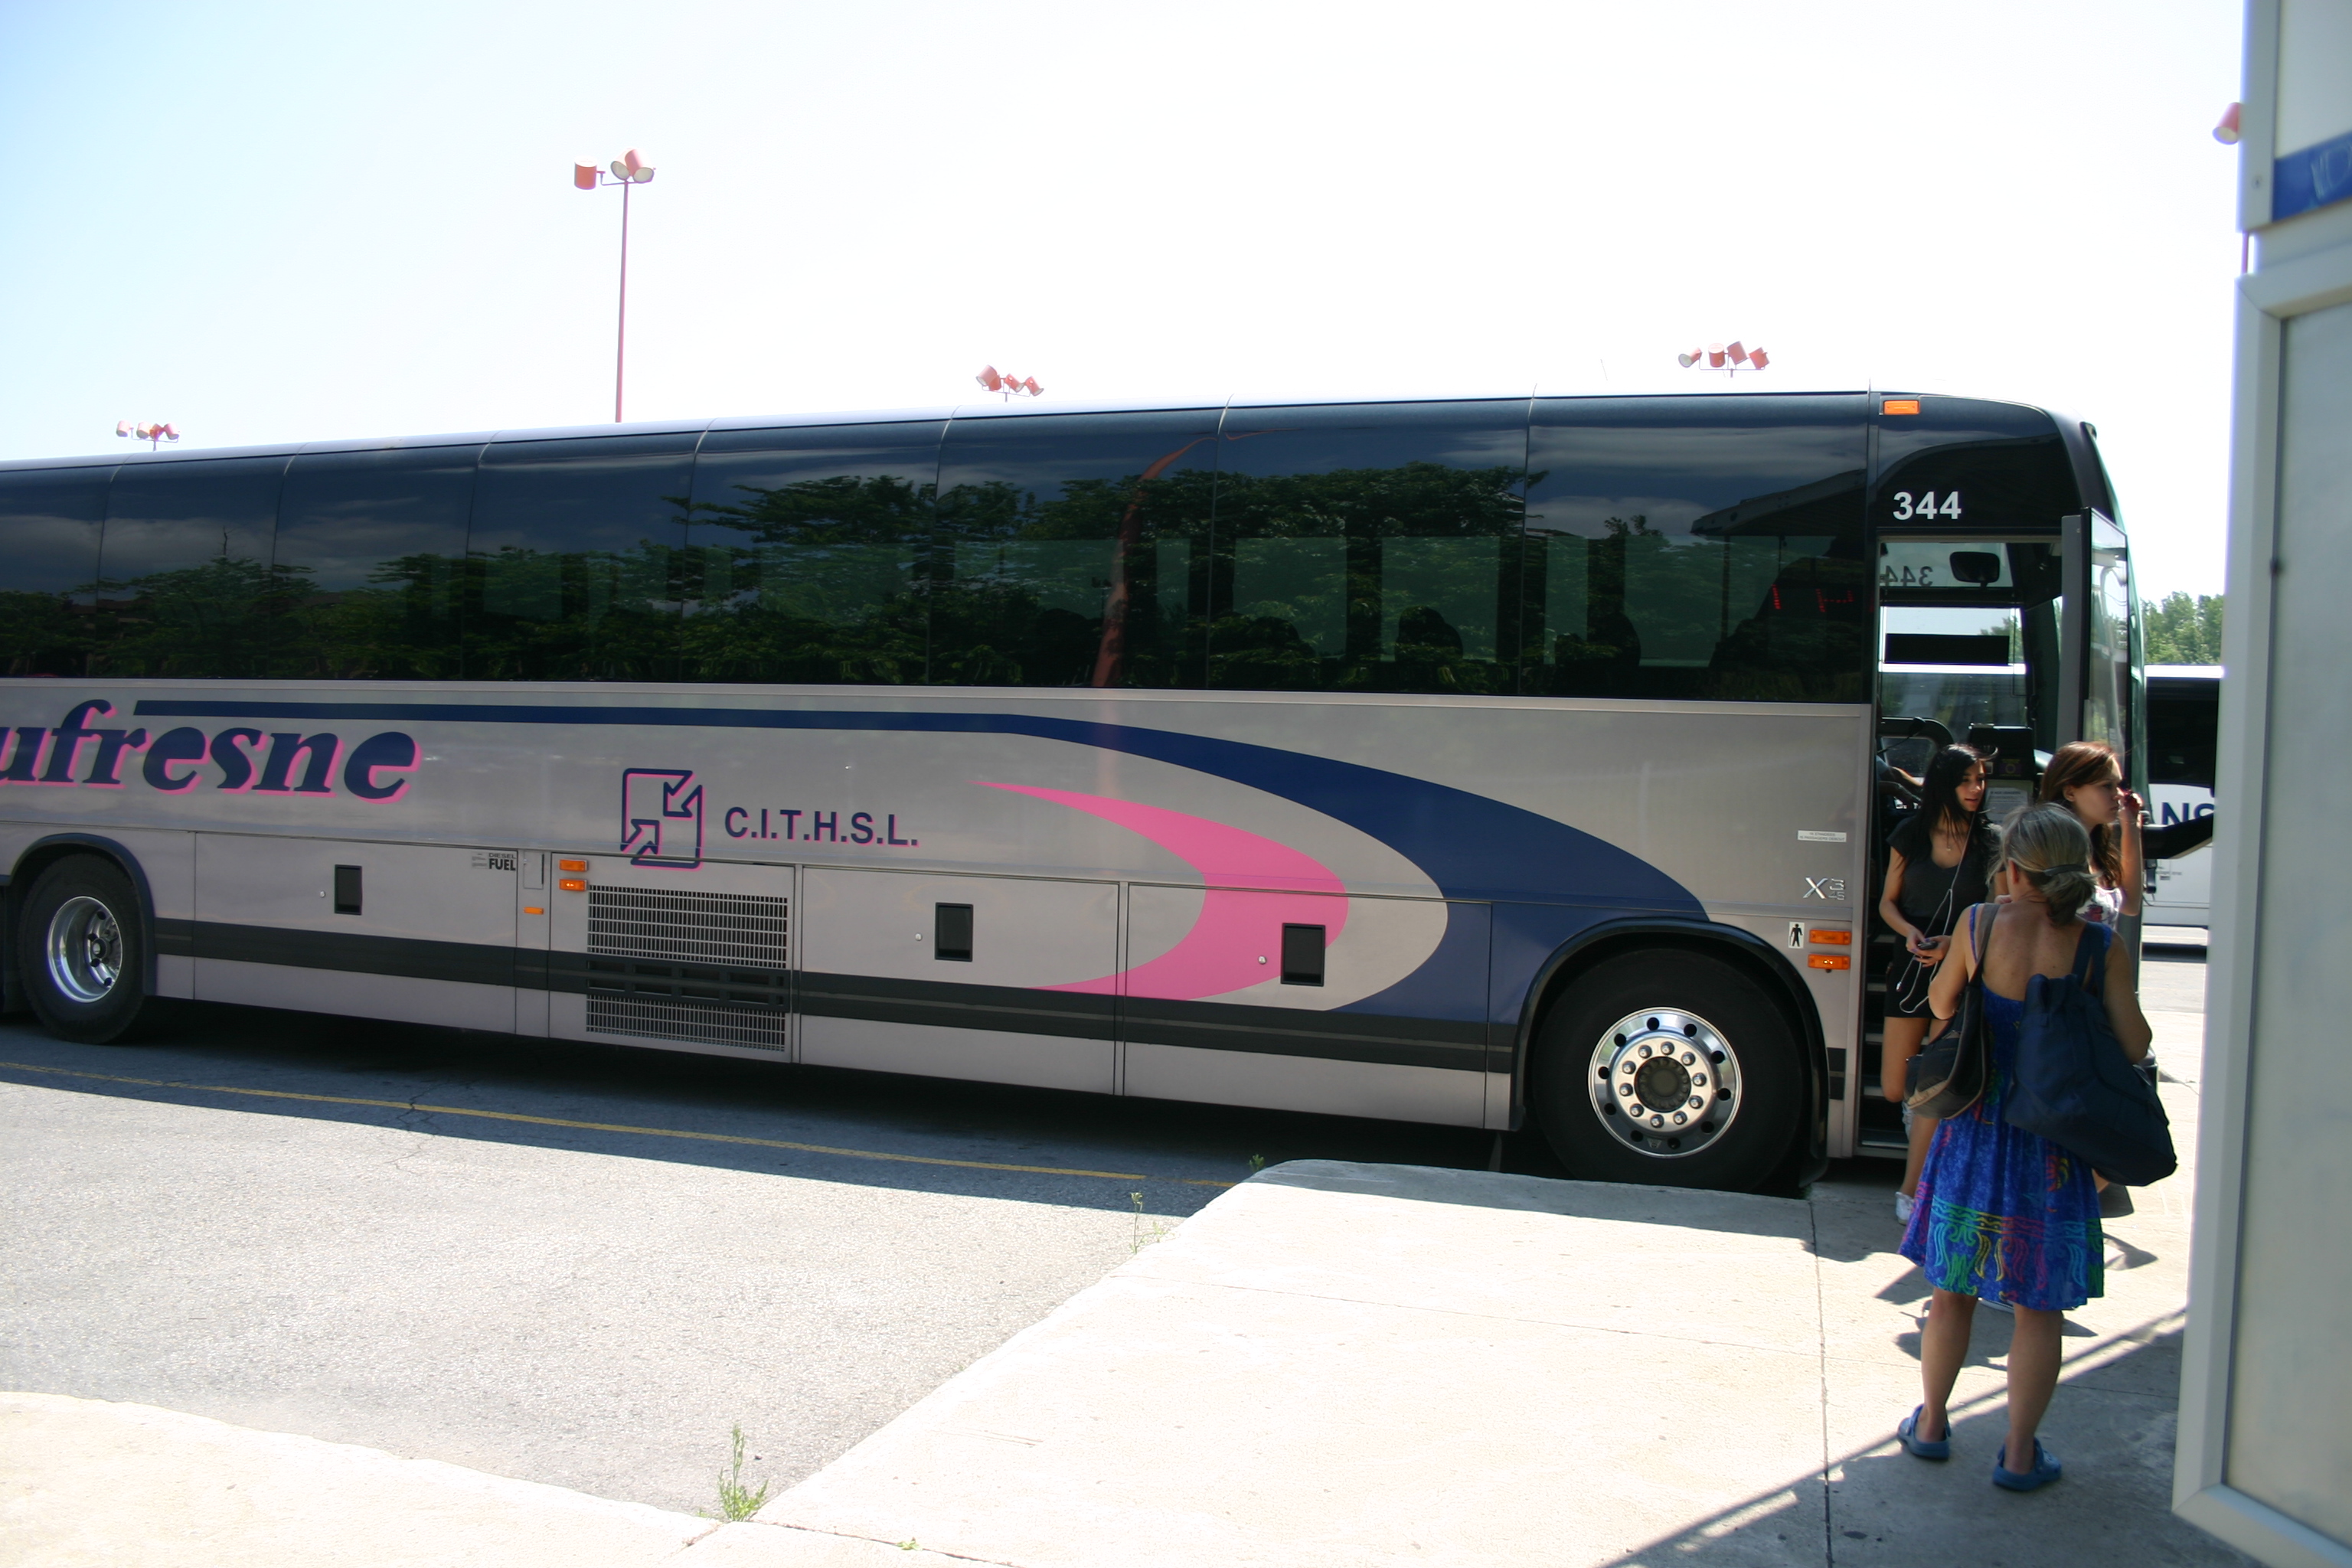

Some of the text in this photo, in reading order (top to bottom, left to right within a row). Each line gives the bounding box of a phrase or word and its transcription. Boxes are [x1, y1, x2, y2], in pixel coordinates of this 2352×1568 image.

[1893, 491, 1962, 521] 344
[724, 807, 920, 847] C.I.T.H.S.L.
[488, 858, 516, 871] FUEL
